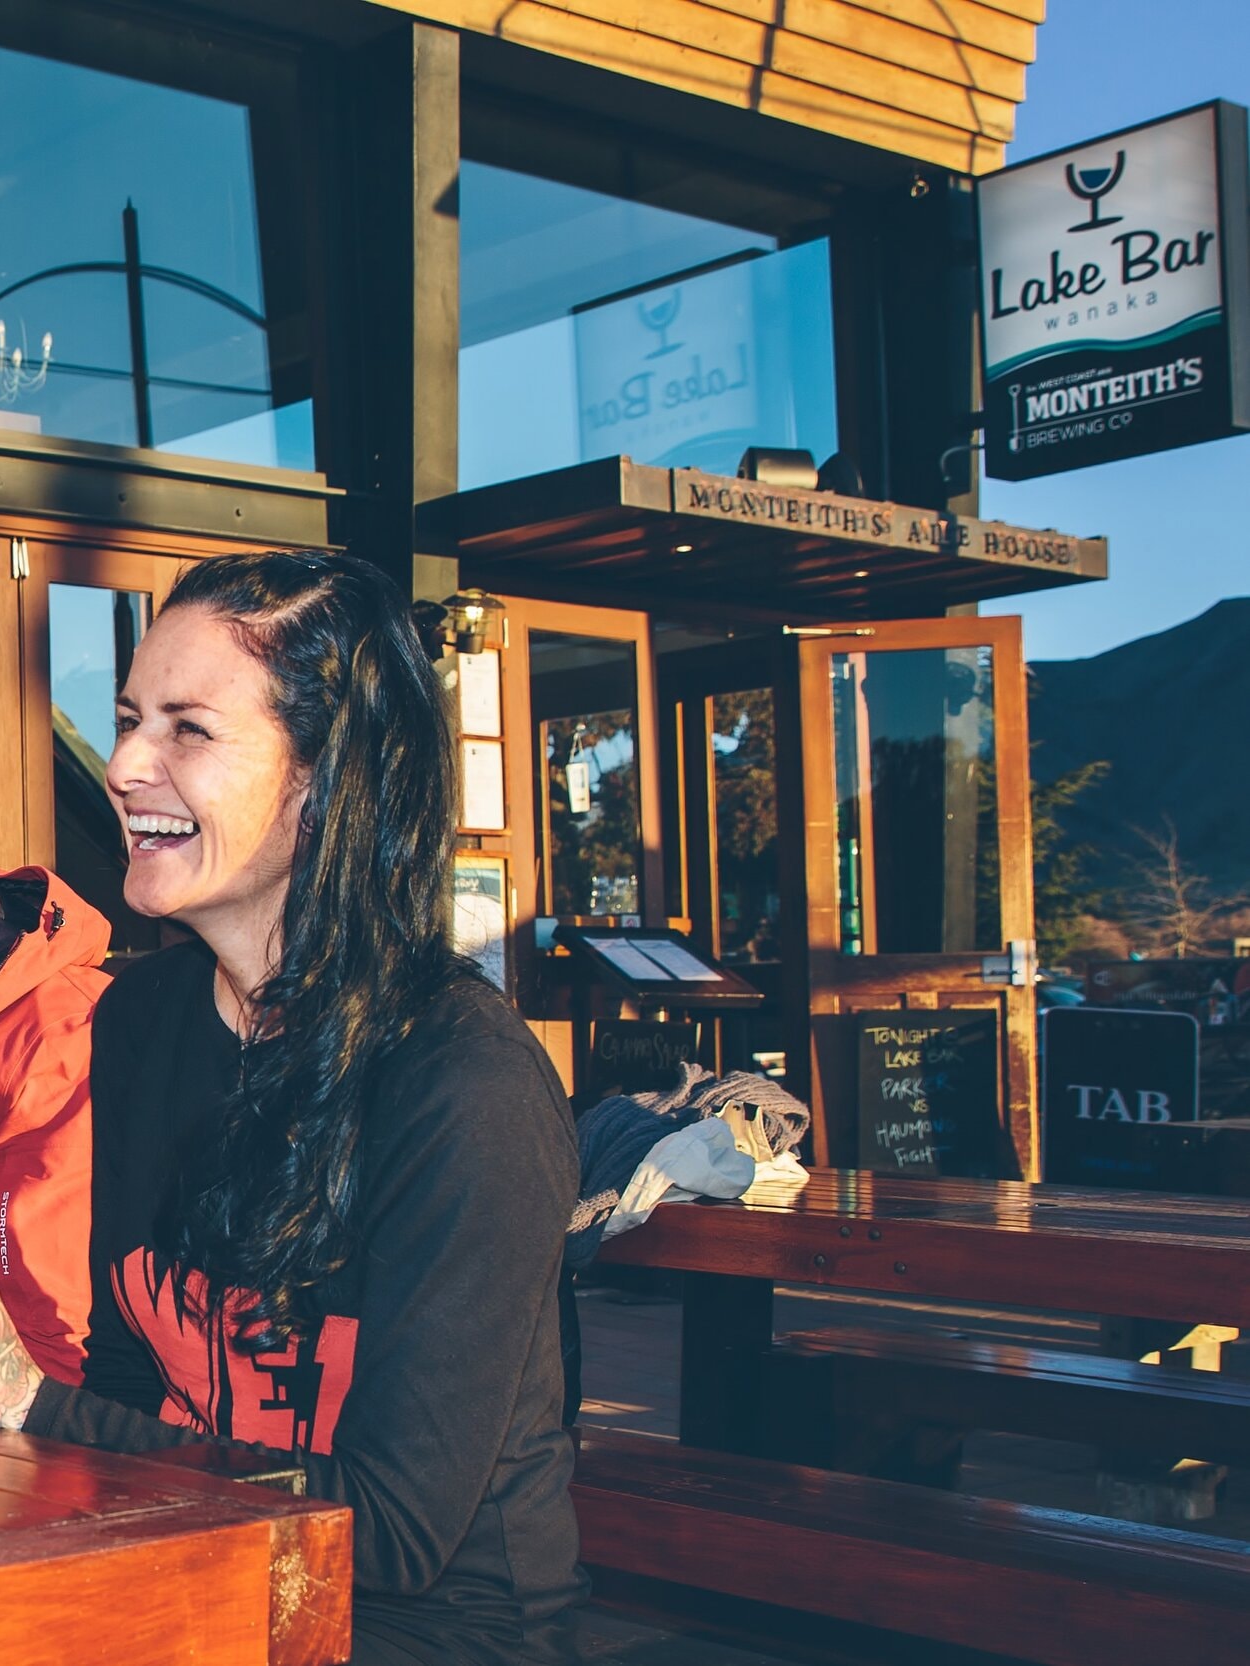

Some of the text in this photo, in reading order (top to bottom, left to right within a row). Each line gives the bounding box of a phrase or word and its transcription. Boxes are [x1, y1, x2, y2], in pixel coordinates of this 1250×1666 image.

[991, 230, 1214, 320] Lake Bar
[1044, 290, 1158, 331] wanaka
[1026, 357, 1203, 423] MONTEITH'S
[1026, 417, 1104, 449] BREWING
[864, 1026, 941, 1046] TONIGHT
[885, 1050, 922, 1068] LAKE
[1066, 1084, 1174, 1125] TAB
[0, 1191, 10, 1275] STORMTECH
